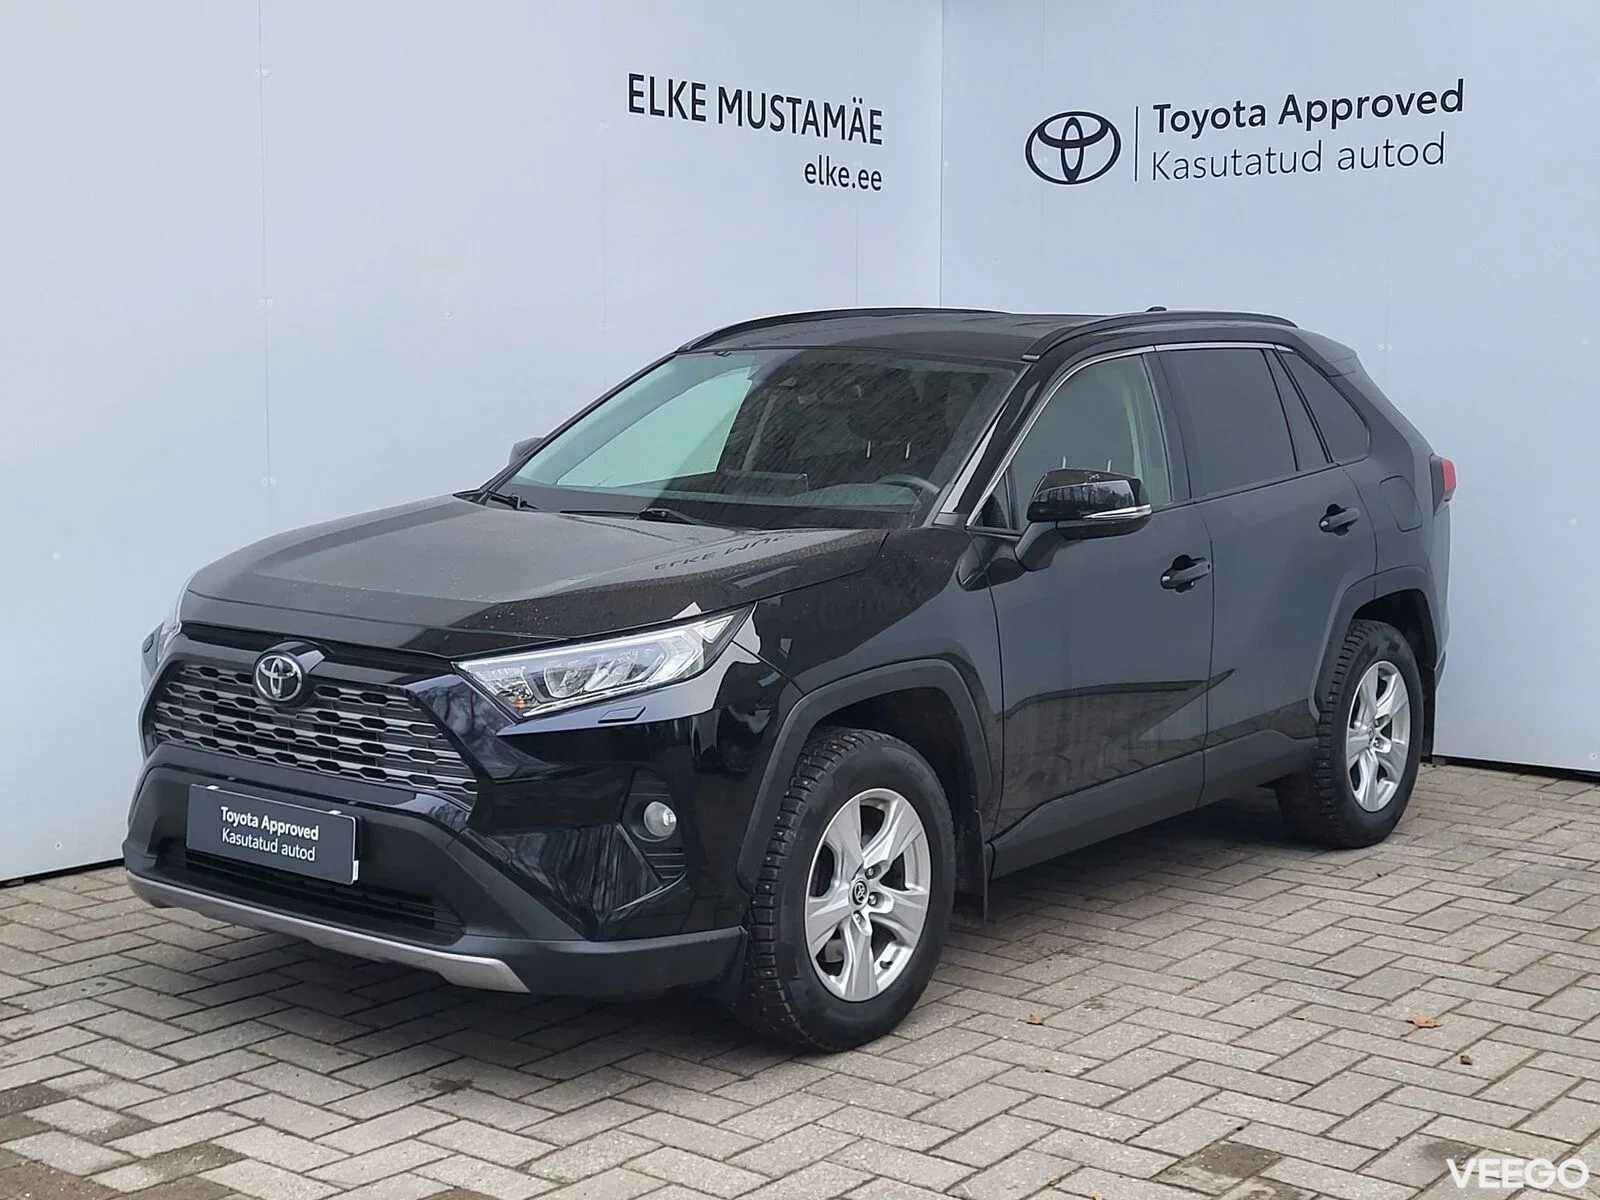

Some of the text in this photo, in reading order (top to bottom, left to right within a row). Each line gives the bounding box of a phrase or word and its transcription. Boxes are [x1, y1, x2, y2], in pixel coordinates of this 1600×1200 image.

[628, 72, 883, 146] ELKE MUSTAMÄE
[1152, 78, 1465, 140] Toyota Approved
[804, 154, 882, 191] elke.ee
[1152, 130, 1446, 182] Kasutatud autod
[220, 806, 320, 841] Toyota Approved
[222, 827, 316, 862] Kasutatud autod
